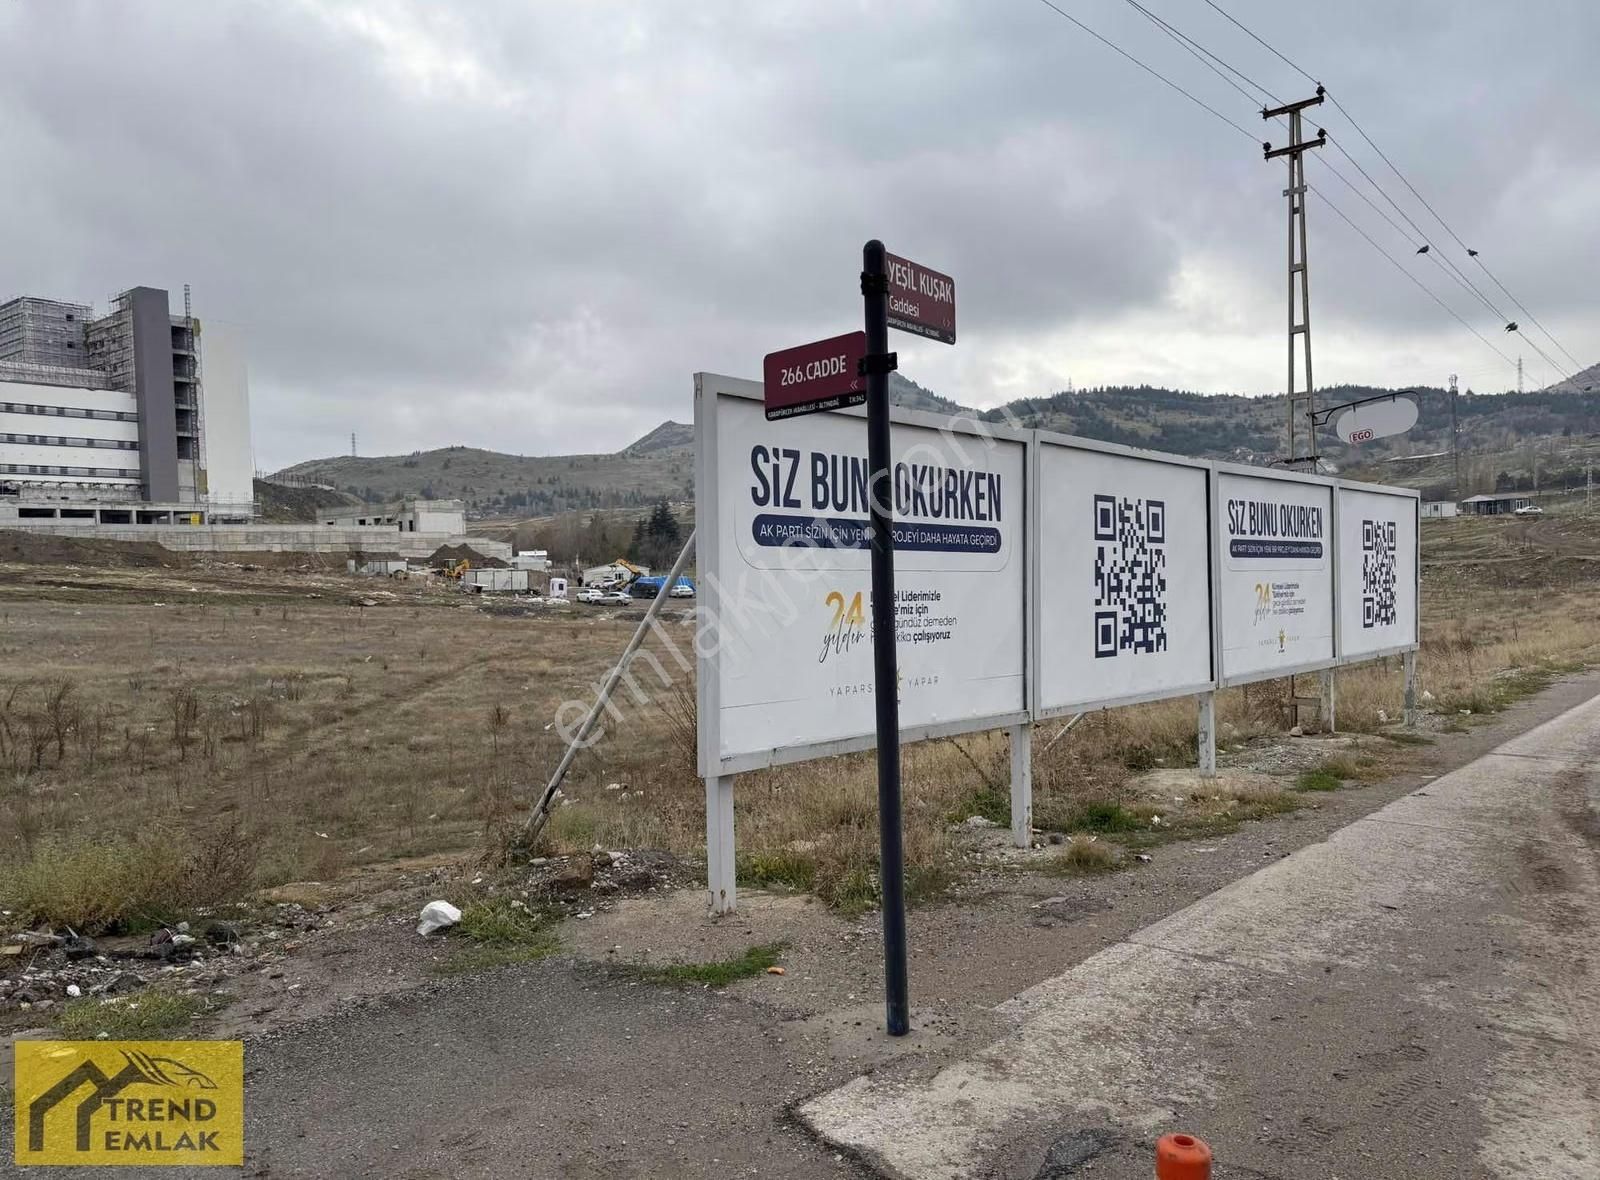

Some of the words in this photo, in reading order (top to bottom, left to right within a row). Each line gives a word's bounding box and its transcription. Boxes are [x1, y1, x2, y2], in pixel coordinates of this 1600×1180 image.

[888, 260, 917, 291] YEŞİL
[920, 272, 953, 304] KUŞAK
[889, 295, 920, 317] Caddesi
[781, 355, 847, 387] 266.CADDE
[1352, 430, 1371, 441] EGO
[811, 452, 869, 513] BUN
[895, 462, 1002, 522] OKURKEN
[1248, 501, 1277, 537] BUNU
[1280, 503, 1322, 538] OKURKEN
[760, 524, 774, 537] AK
[776, 523, 803, 538] PARTİ
[805, 525, 828, 540] SİZİN
[893, 529, 919, 544] ROJEYİ
[920, 531, 941, 544] DAHA
[942, 532, 969, 546] HAYATA
[901, 590, 941, 602] Liderimizle
[825, 591, 865, 628] 24
[915, 603, 928, 617] için
[923, 616, 957, 628] demeden
[913, 630, 951, 645] çalışıyoruz
[907, 676, 939, 688] YAPAR
